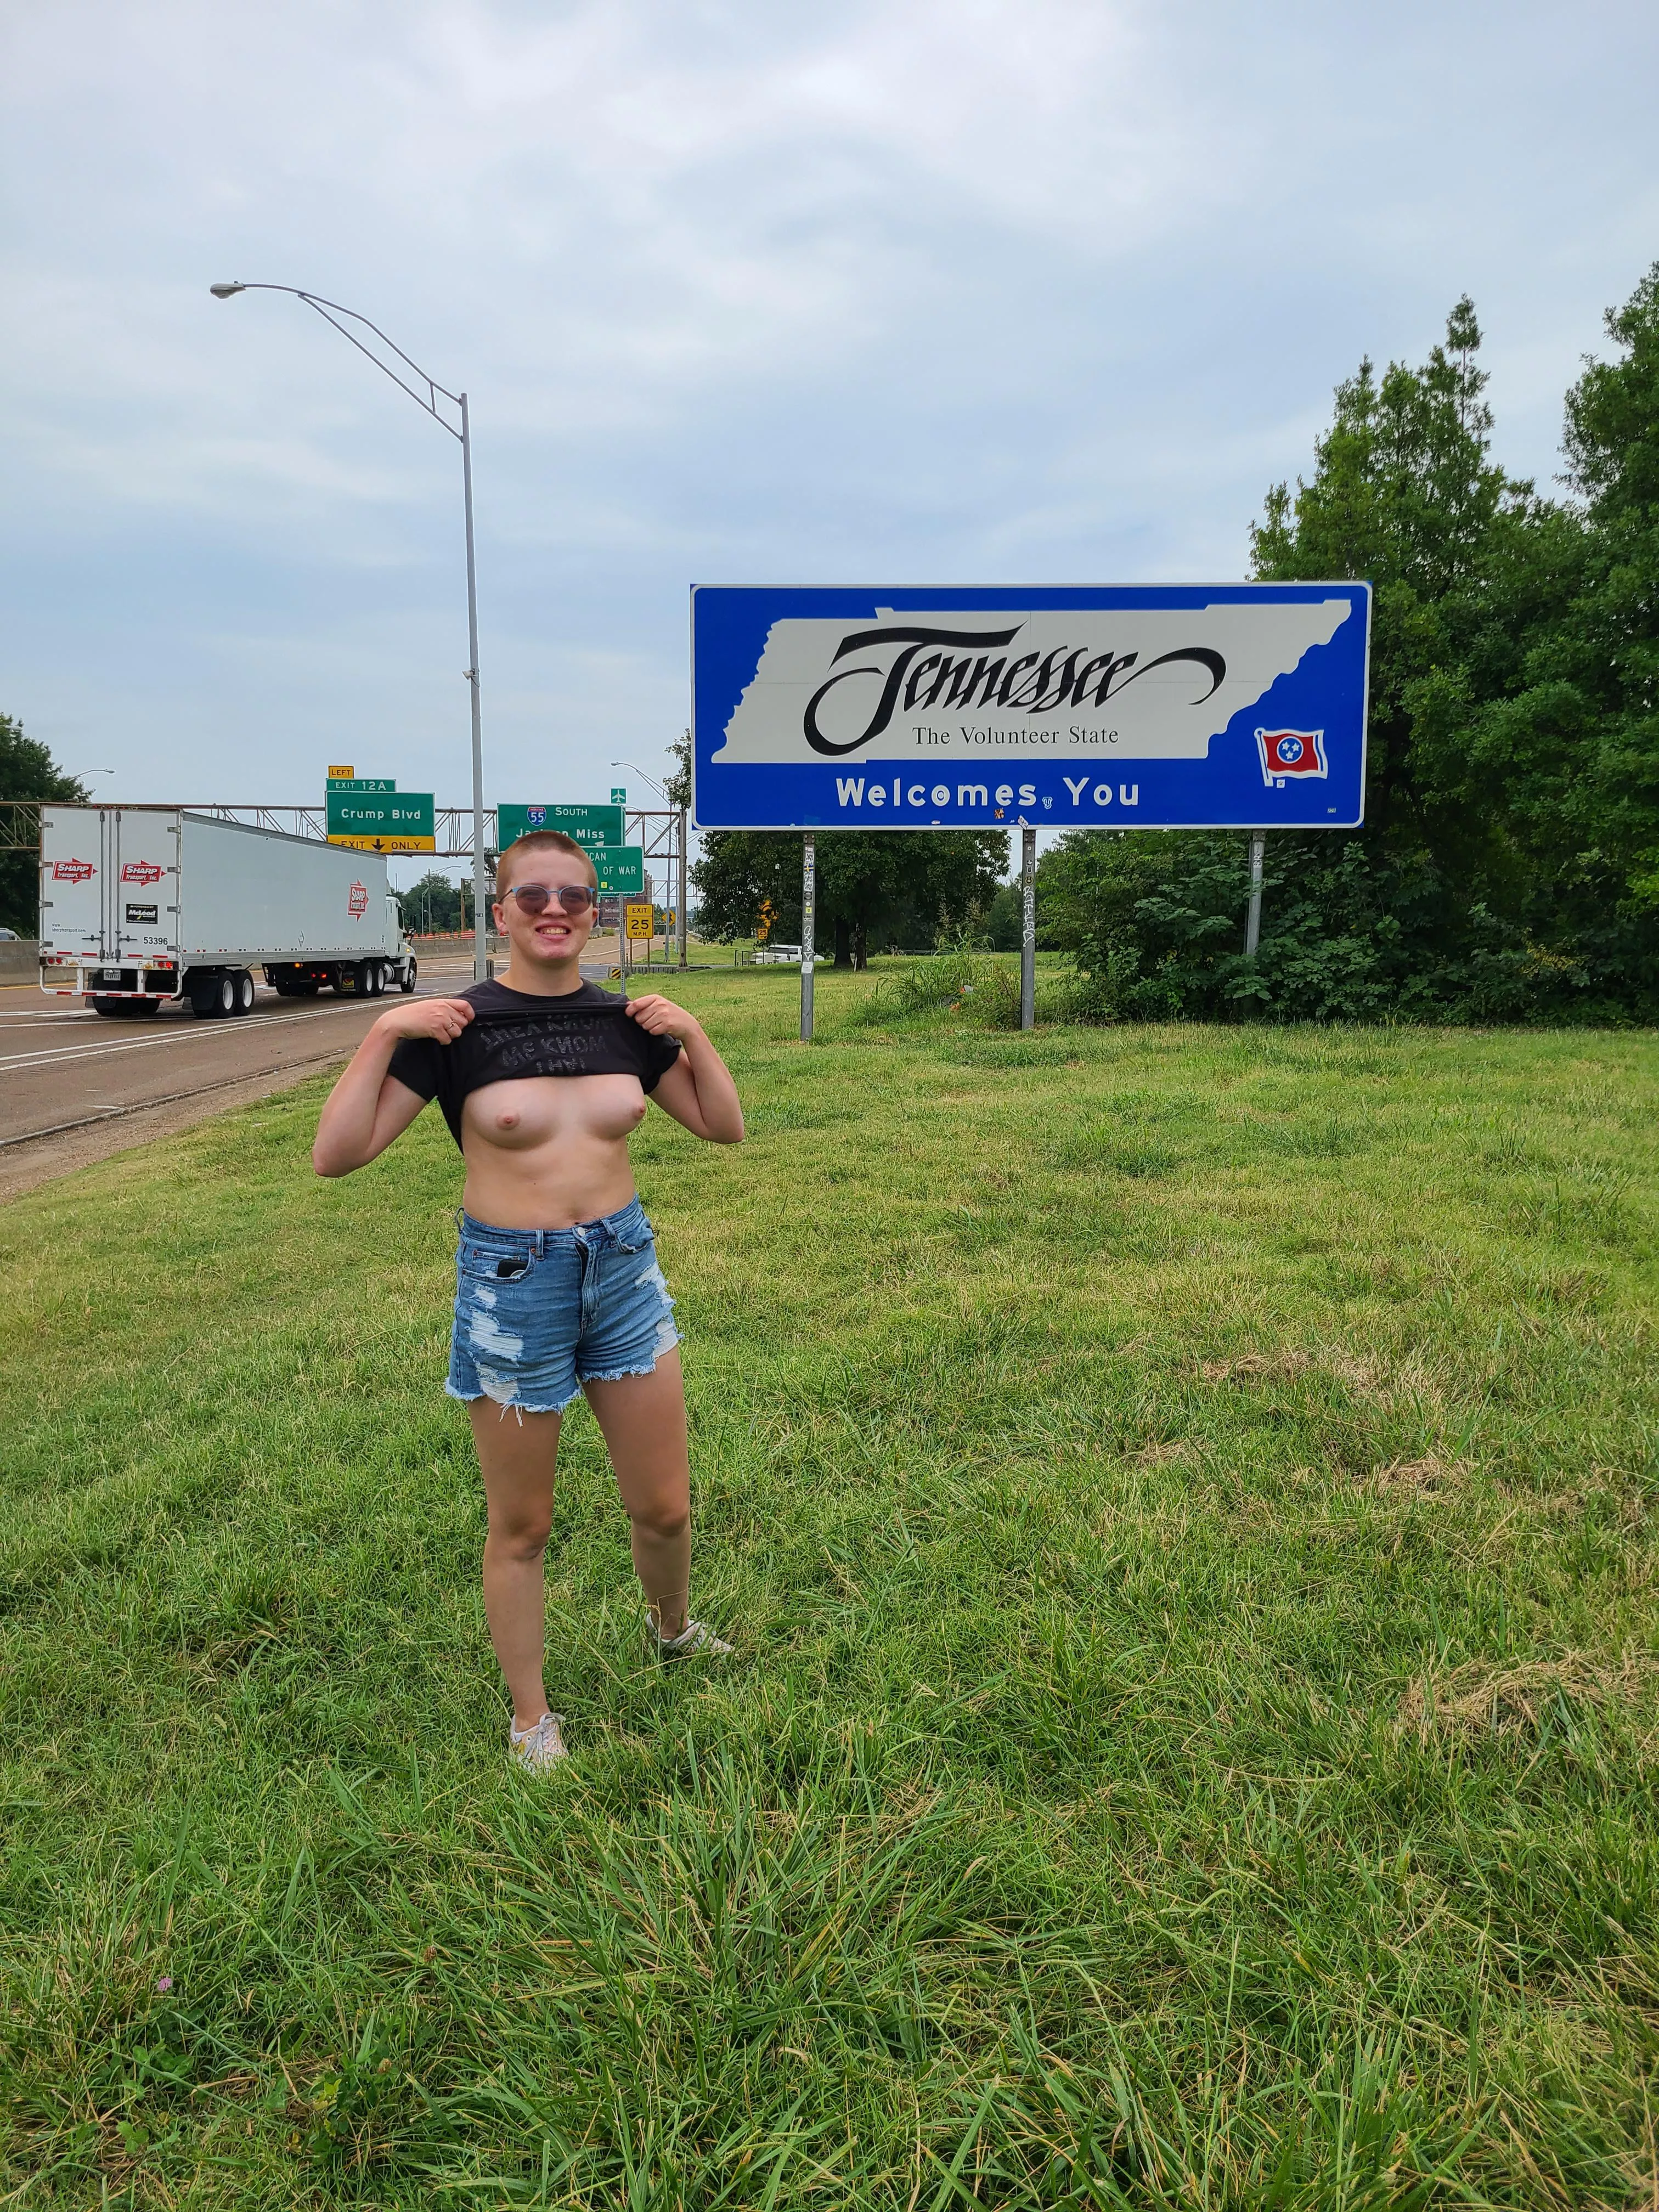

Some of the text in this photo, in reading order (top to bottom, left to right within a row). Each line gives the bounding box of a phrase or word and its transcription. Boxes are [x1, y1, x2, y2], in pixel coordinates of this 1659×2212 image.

[803, 620, 1226, 756] Tennessee
[912, 726, 1119, 744] The Volunteer State
[362, 781, 386, 791] 12A
[836, 777, 1138, 807] Welcomes You
[341, 808, 421, 820] Crump Blvd
[555, 807, 588, 816] SOUTH
[531, 812, 544, 822] 55
[577, 829, 605, 839] Miss
[391, 842, 421, 850] ONLY
[58, 864, 89, 872] SHARP
[126, 866, 158, 874] SHARP
[603, 866, 636, 875] OF WAR
[631, 919, 649, 930] 25
[143, 936, 168, 945] 53396
